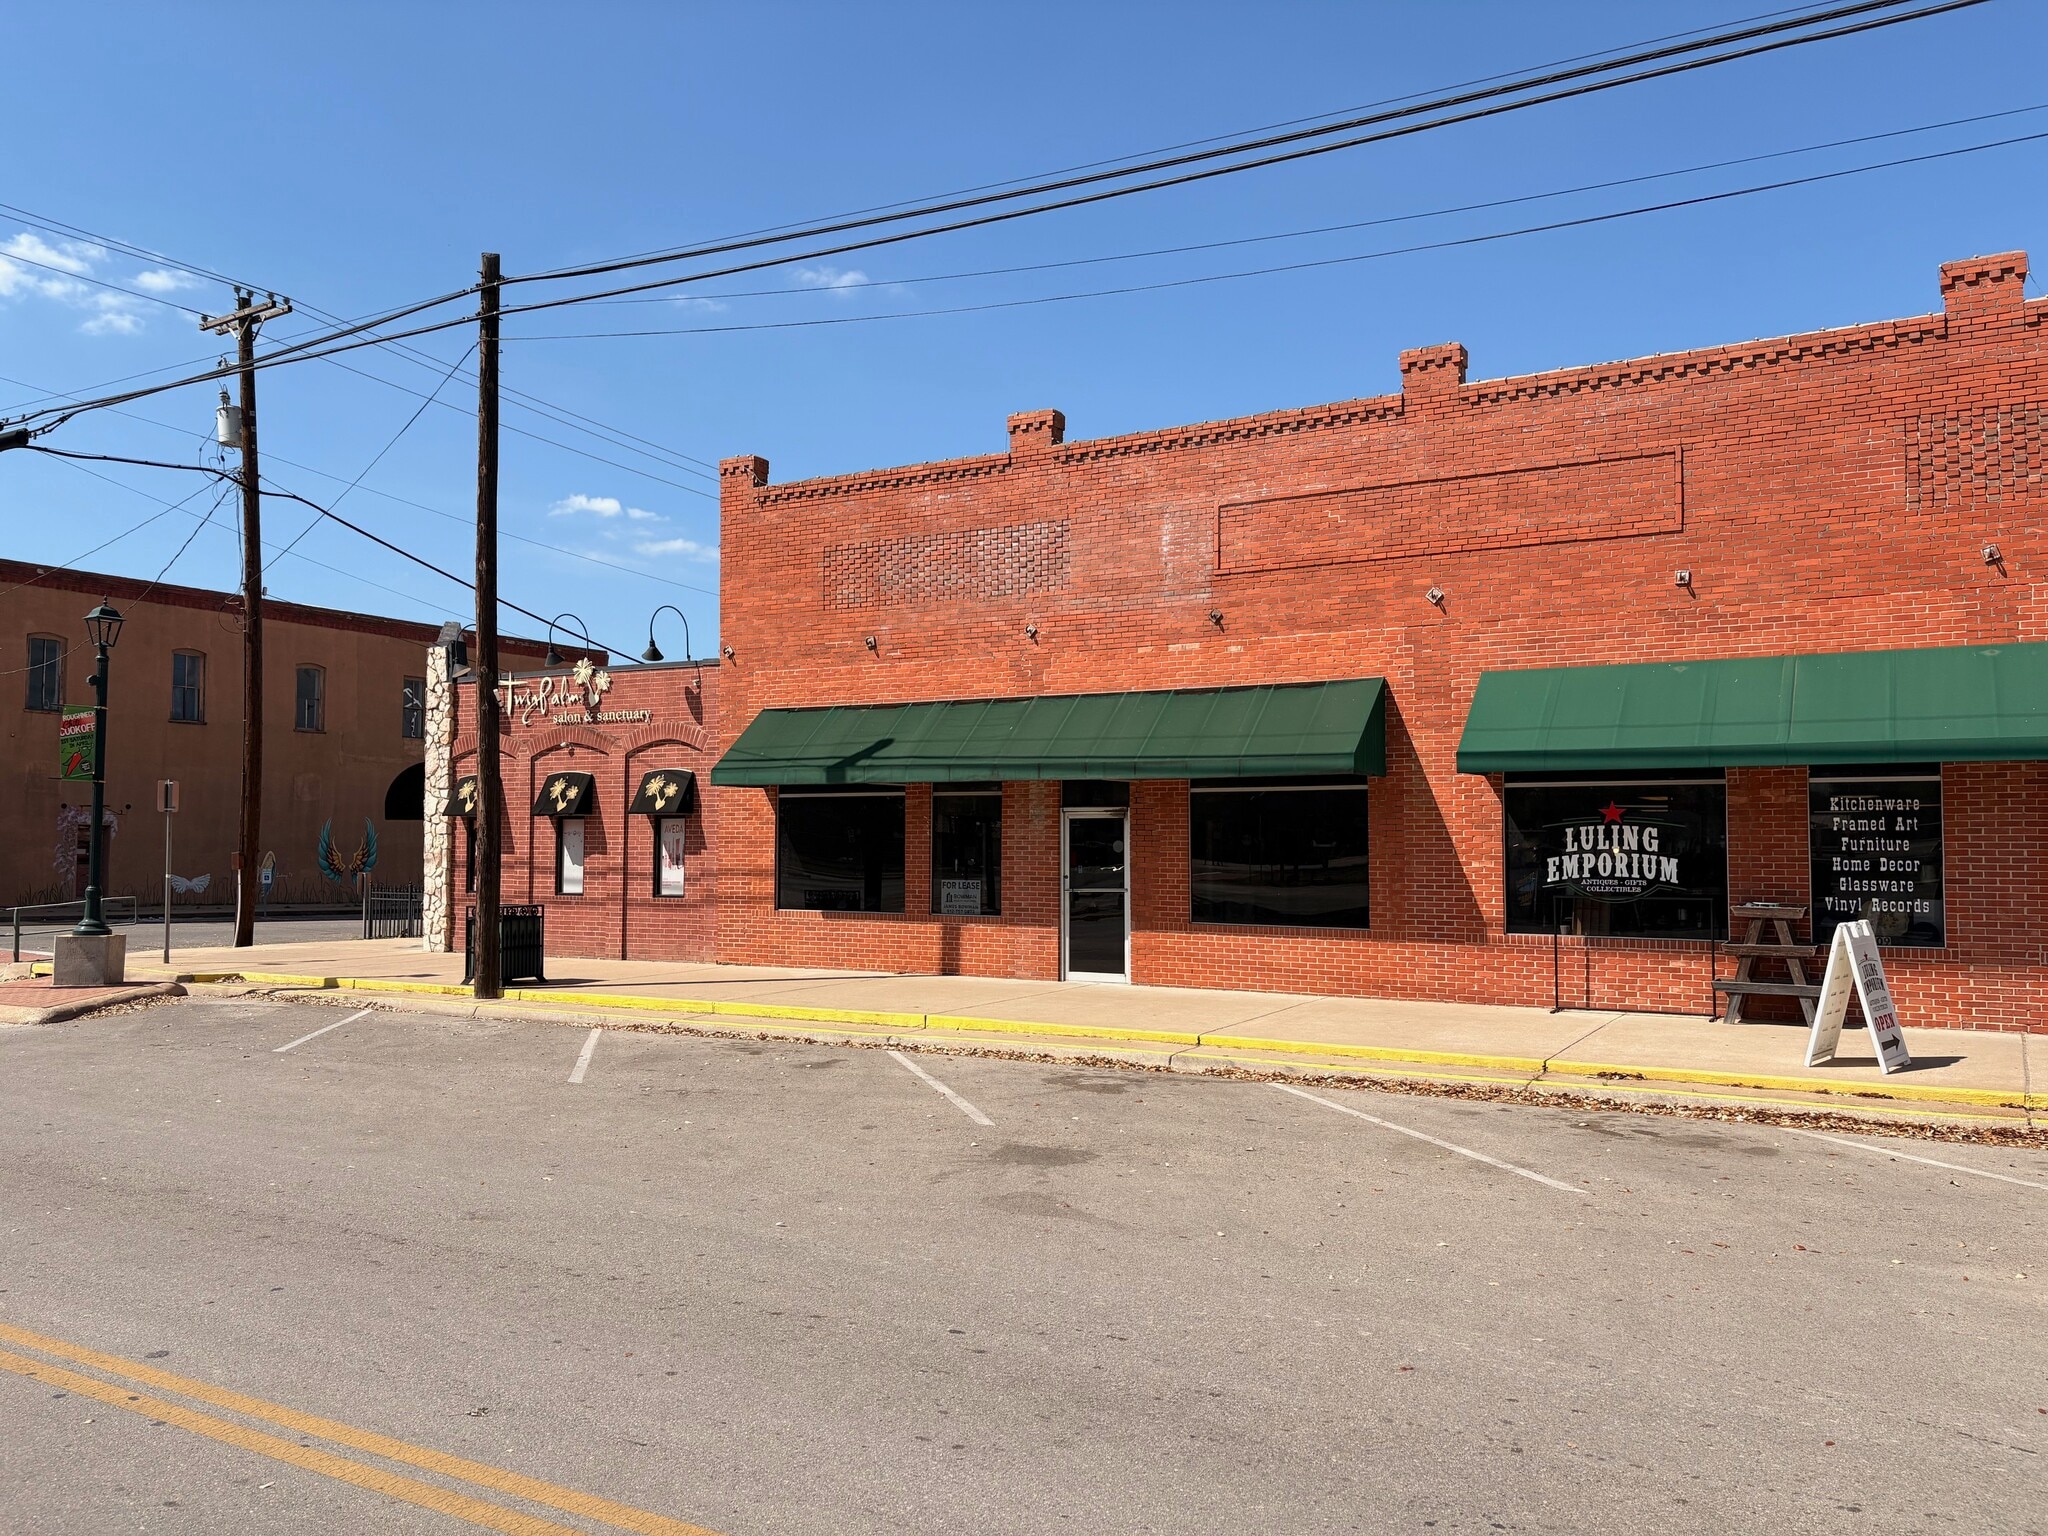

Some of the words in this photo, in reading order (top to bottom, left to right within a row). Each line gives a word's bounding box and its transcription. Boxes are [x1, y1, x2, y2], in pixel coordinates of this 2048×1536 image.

[553, 711, 581, 723] salon
[584, 710, 594, 722] &
[597, 709, 651, 723] sanctuary
[70, 734, 94, 743] SATURDAY
[1830, 797, 1920, 811] Kitchenware
[664, 824, 684, 833] AVEDA
[1833, 817, 1886, 831] Framed
[1895, 817, 1919, 831] Art
[1565, 825, 1659, 852] LULING
[1841, 837, 1910, 851] Furniture
[1547, 852, 1679, 884] EMPORIUM
[1832, 857, 1870, 871] Home
[1880, 858, 1920, 871] Decor
[942, 881, 957, 889] FOR
[958, 881, 980, 890] LEASE
[1839, 877, 1914, 892] Glassware
[1824, 897, 1862, 914] Vinyl
[1872, 898, 1930, 913] Records
[1875, 1012, 1896, 1032] OPEN
